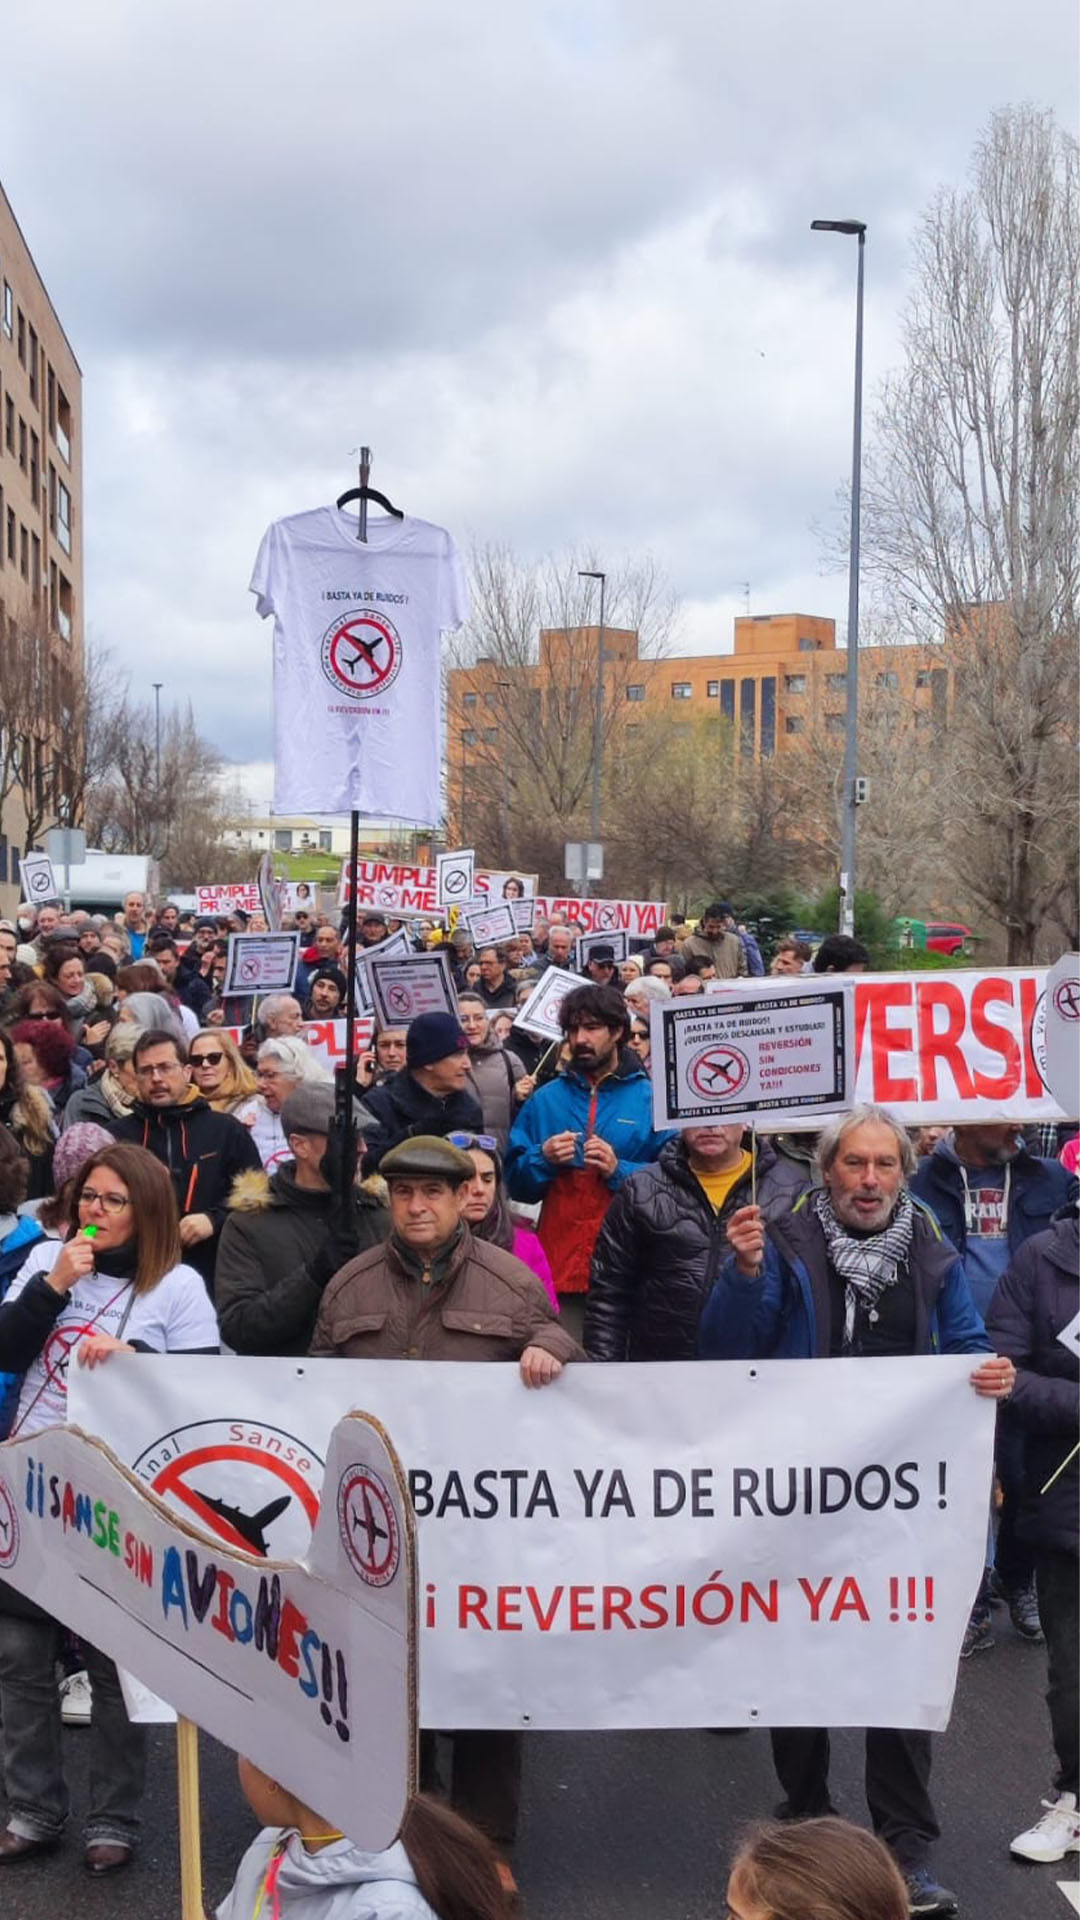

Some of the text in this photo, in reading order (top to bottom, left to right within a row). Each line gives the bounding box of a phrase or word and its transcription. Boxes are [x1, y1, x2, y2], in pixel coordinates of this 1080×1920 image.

[326, 591, 351, 601] BASTA
[352, 591, 363, 601] YA
[363, 591, 374, 601] DE
[199, 884, 258, 900] CUMPLE
[714, 1021, 725, 1029] YA
[727, 1019, 737, 1028] DE
[731, 1026, 776, 1039] DESCANSAR
[778, 1025, 783, 1033] Y
[758, 1036, 812, 1051] REVERSIÓN
[758, 1056, 775, 1065] SIN
[759, 1063, 821, 1079] CONDICIONES
[229, 1424, 312, 1474] Sanse
[137, 1436, 182, 1482] inal
[408, 1461, 948, 1520] BASTA YA DE RUIDOS !
[124, 1531, 154, 1588] SIN
[457, 1570, 779, 1632] REVERSIÓN
[793, 1575, 871, 1623] YA
[888, 1575, 936, 1623] !!!
